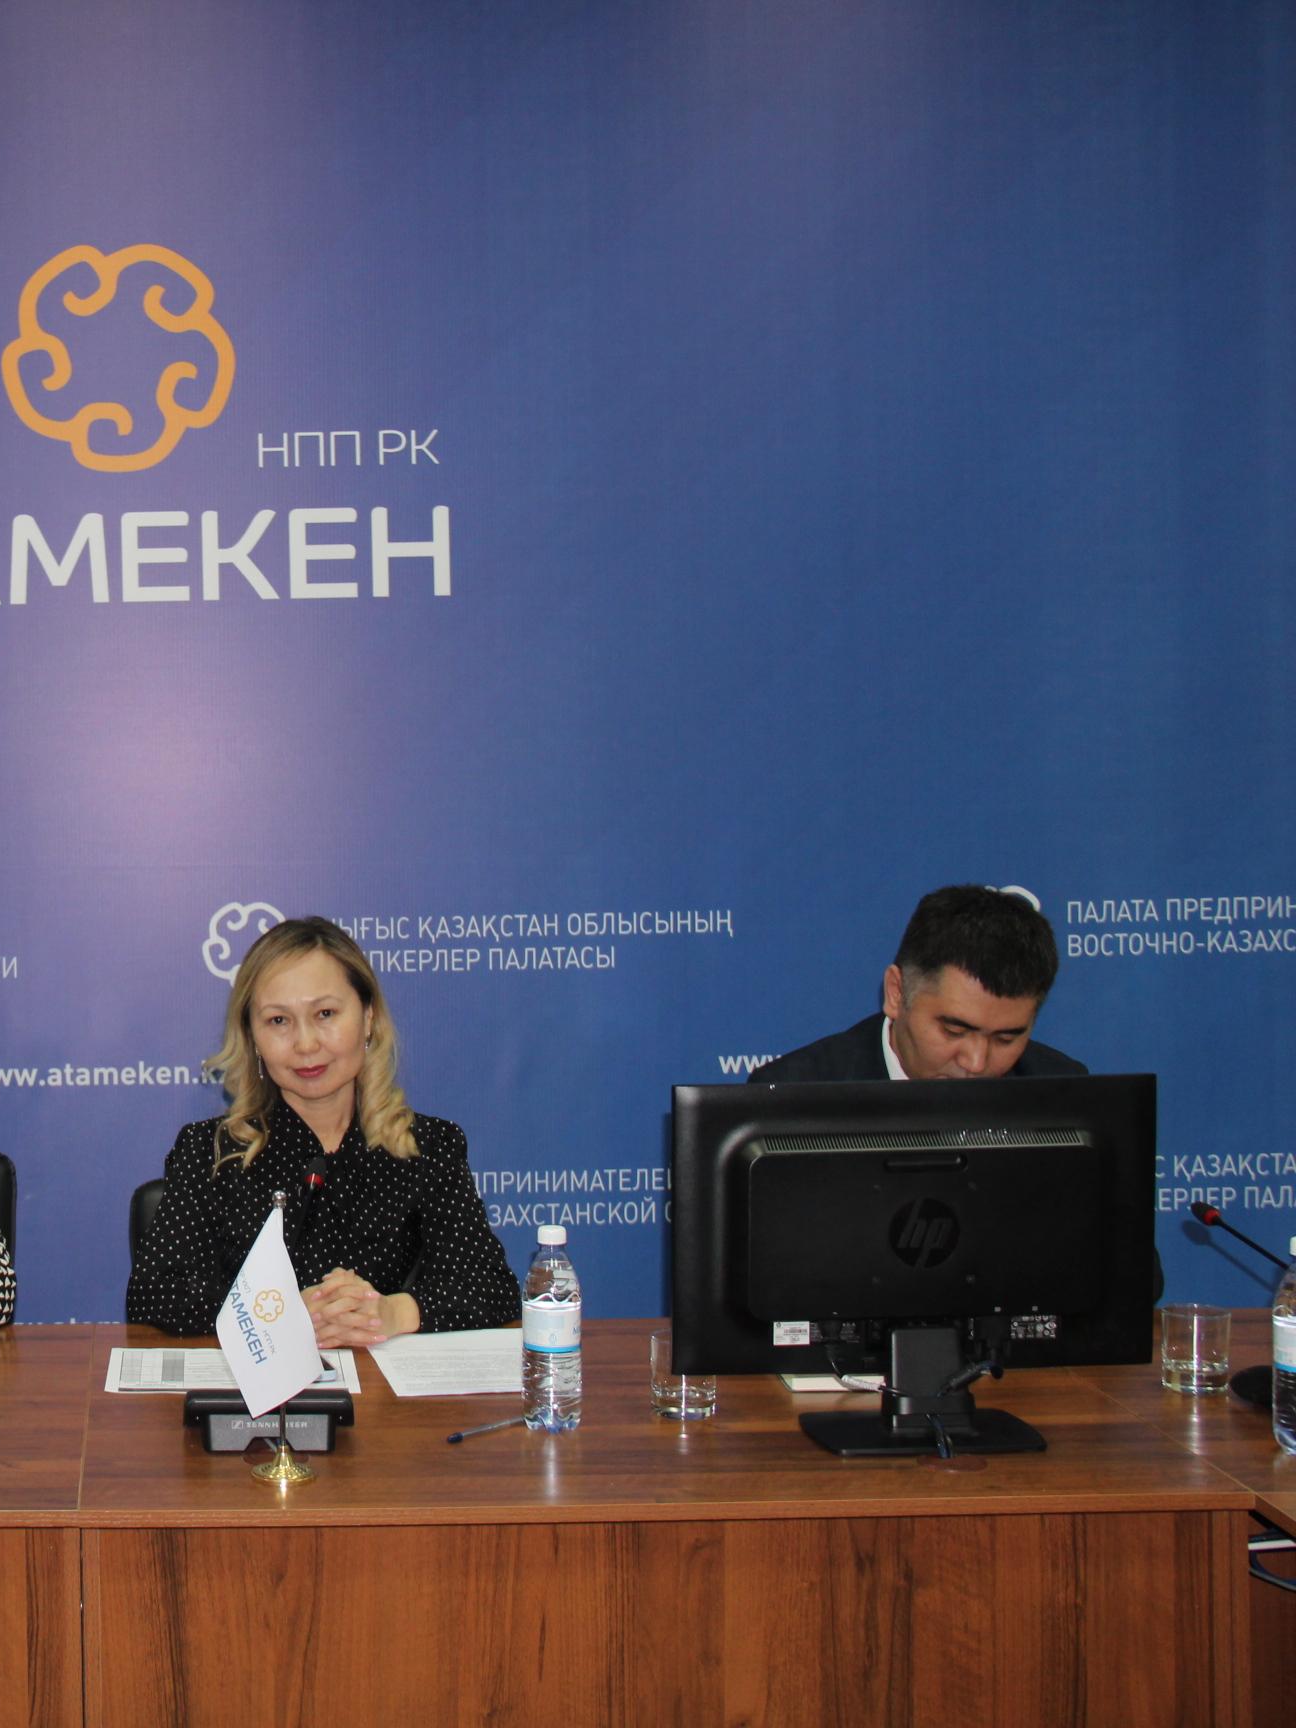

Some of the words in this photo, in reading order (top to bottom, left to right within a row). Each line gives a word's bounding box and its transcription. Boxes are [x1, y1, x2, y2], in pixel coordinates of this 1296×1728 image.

[257, 431, 361, 468] НПП
[378, 428, 440, 467] РК
[1066, 899, 1159, 924] ПАЛАТА
[332, 916, 410, 940] ЫҒЫС
[418, 914, 559, 944] ҚАЗАҚСТАН
[567, 909, 734, 938] ОБЛЫСЫНЫҢ
[1067, 928, 1296, 958] ВОСТОЧНО-КАЗАХС
[363, 948, 481, 972] ПКЕРЛЕР
[488, 945, 616, 970] ПАЛАТАСЫ
[1154, 1186, 1237, 1212] ЕРЛЕР
[1244, 1185, 1296, 1210] ПАЛ
[245, 1421, 308, 1429] SENNHISER
